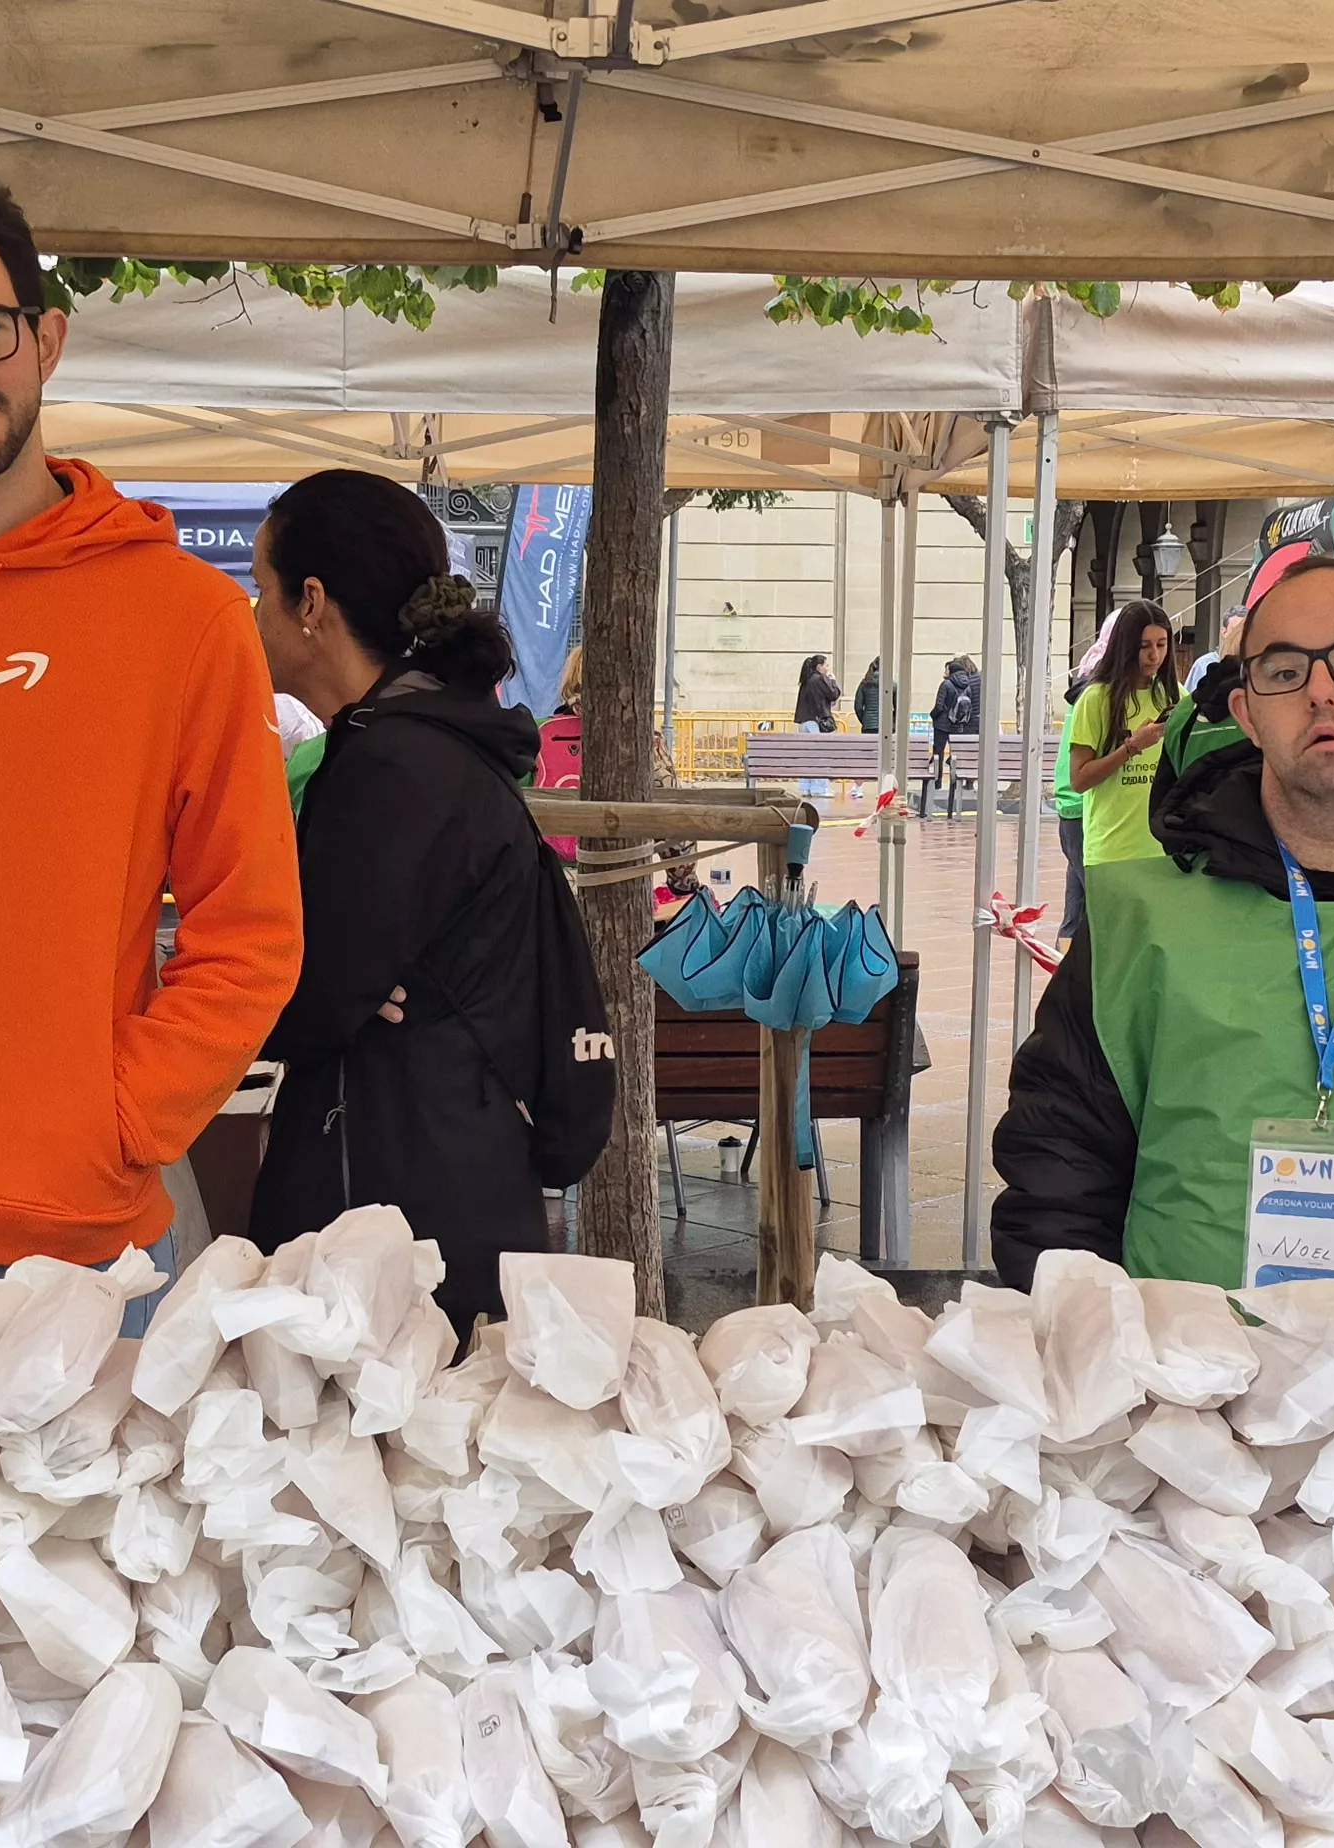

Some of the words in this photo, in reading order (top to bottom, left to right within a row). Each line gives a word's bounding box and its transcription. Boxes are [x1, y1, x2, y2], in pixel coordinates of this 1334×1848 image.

[535, 548, 557, 630] HAD
[549, 484, 574, 540] ME
[1301, 929, 1319, 969] DOWN
[1260, 1155, 1334, 1181] DOWN
[1263, 1197, 1302, 1208] PERSONA
[1271, 1236, 1331, 1260] NOEL
